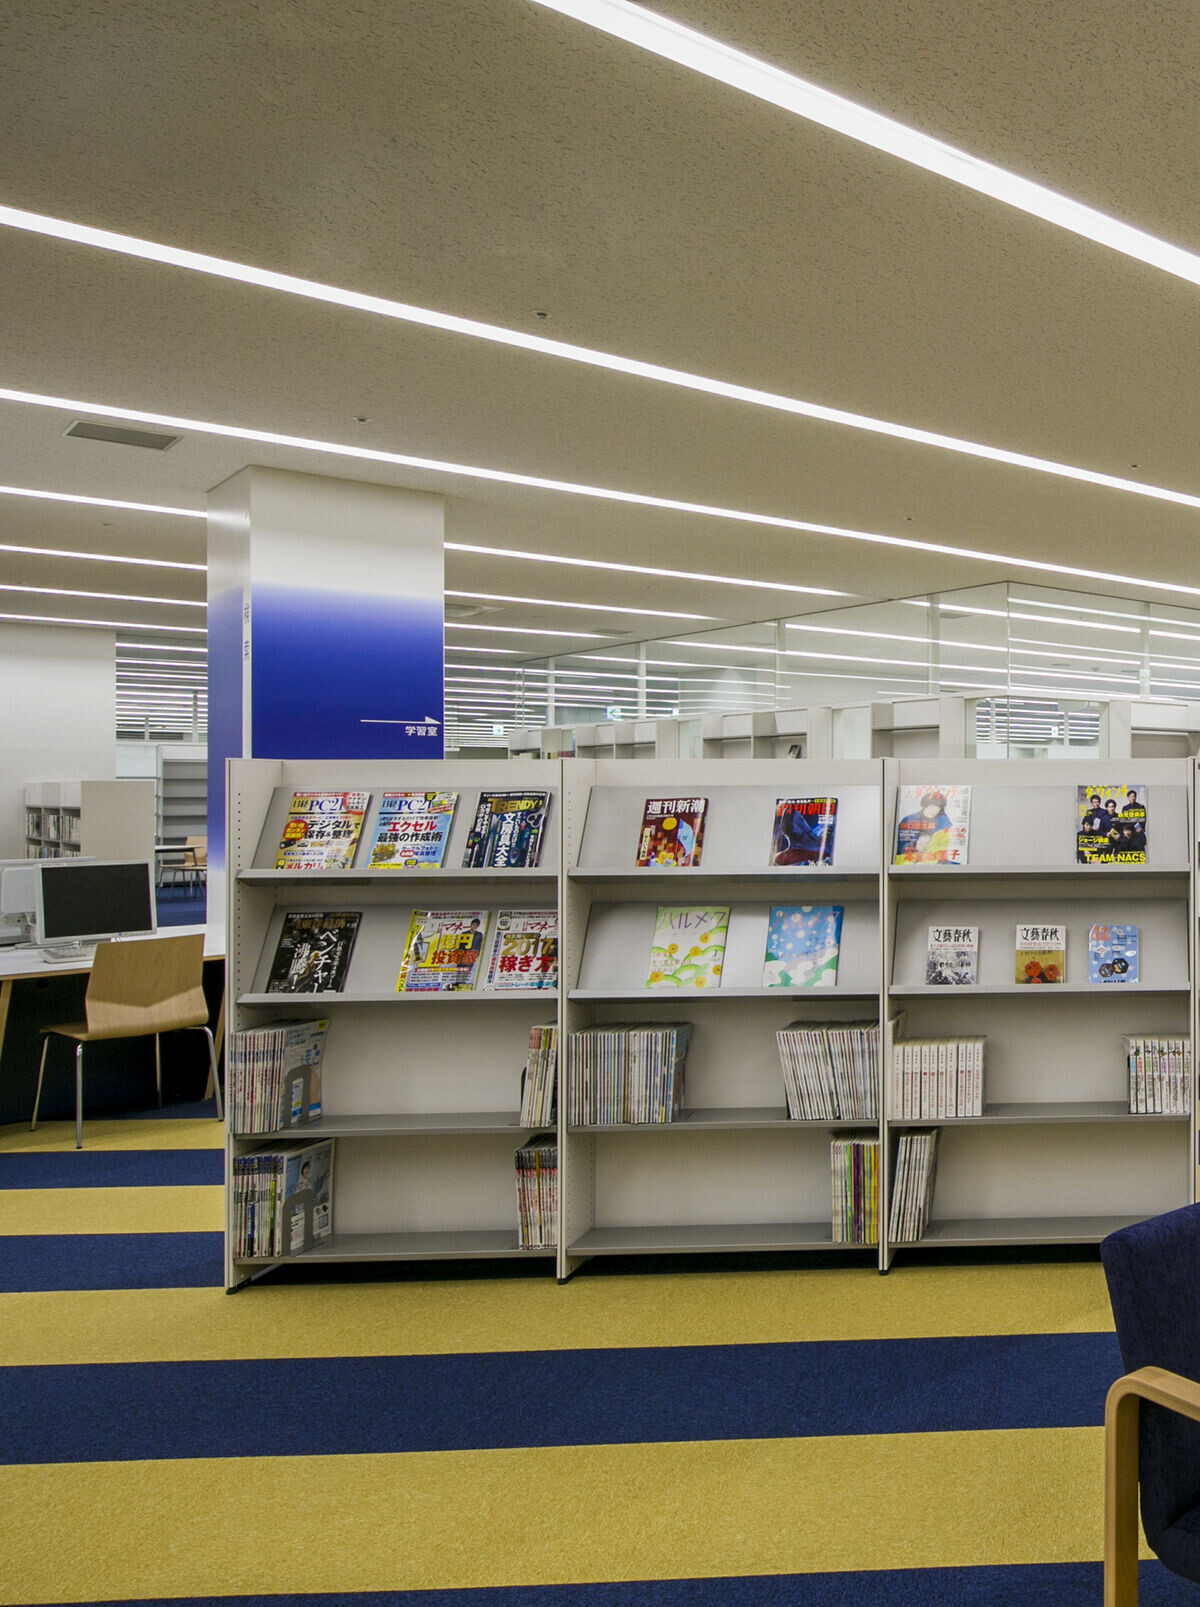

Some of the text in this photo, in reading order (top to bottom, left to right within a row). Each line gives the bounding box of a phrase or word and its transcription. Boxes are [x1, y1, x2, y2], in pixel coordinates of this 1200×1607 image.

[405, 725, 438, 737] 学習室
[487, 798, 538, 814] TRENDY
[646, 799, 706, 815] 週刊新潮
[307, 820, 361, 830] デジタルで
[387, 820, 438, 832] エクセル
[377, 832, 443, 843] 最強の作成術
[1084, 853, 1146, 864] TEAM NACS
[658, 911, 727, 930] ハルメク
[932, 928, 973, 943] 文藝春秋
[1020, 927, 1060, 941] 文藝春秋
[502, 936, 554, 956] 2017
[499, 955, 554, 973] 稼ぎ方
